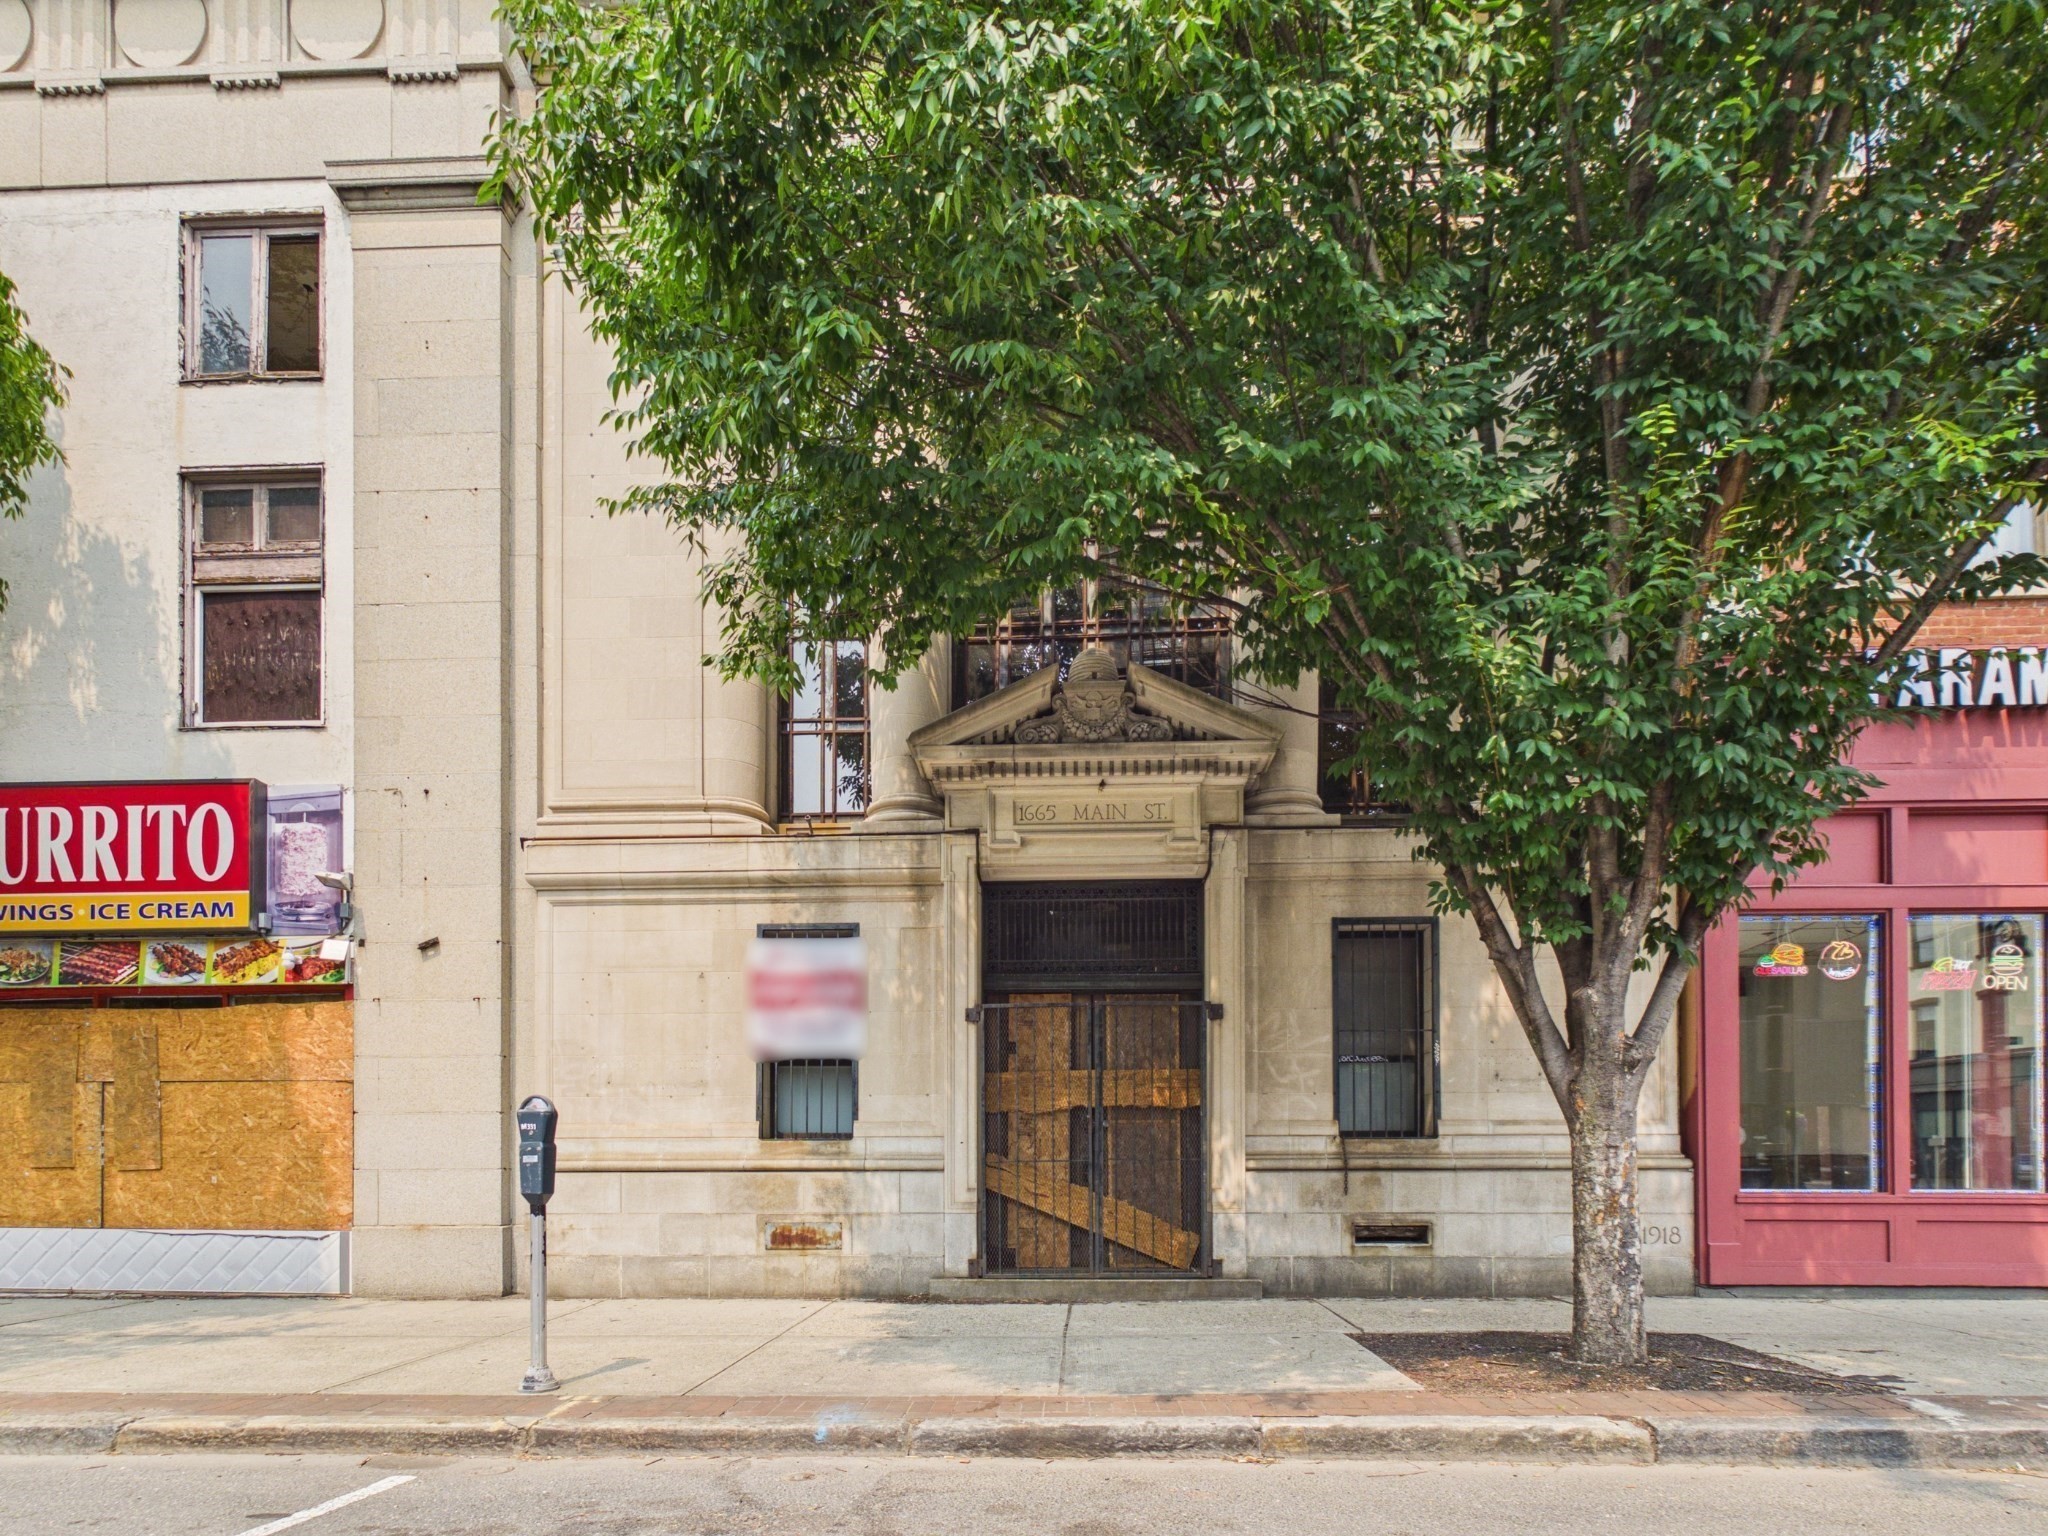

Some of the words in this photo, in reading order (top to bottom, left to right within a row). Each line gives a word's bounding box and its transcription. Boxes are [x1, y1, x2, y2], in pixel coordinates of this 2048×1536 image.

[1019, 804, 1056, 821] 1665
[1073, 803, 1127, 820] MAIN
[1143, 802, 1168, 820] ST.
[89, 903, 131, 920] ICE
[138, 902, 234, 919] CREAM
[1755, 965, 1807, 975] QUESADILLAS
[1983, 975, 2028, 991] OPEN
[1642, 1226, 1681, 1244] 1918
